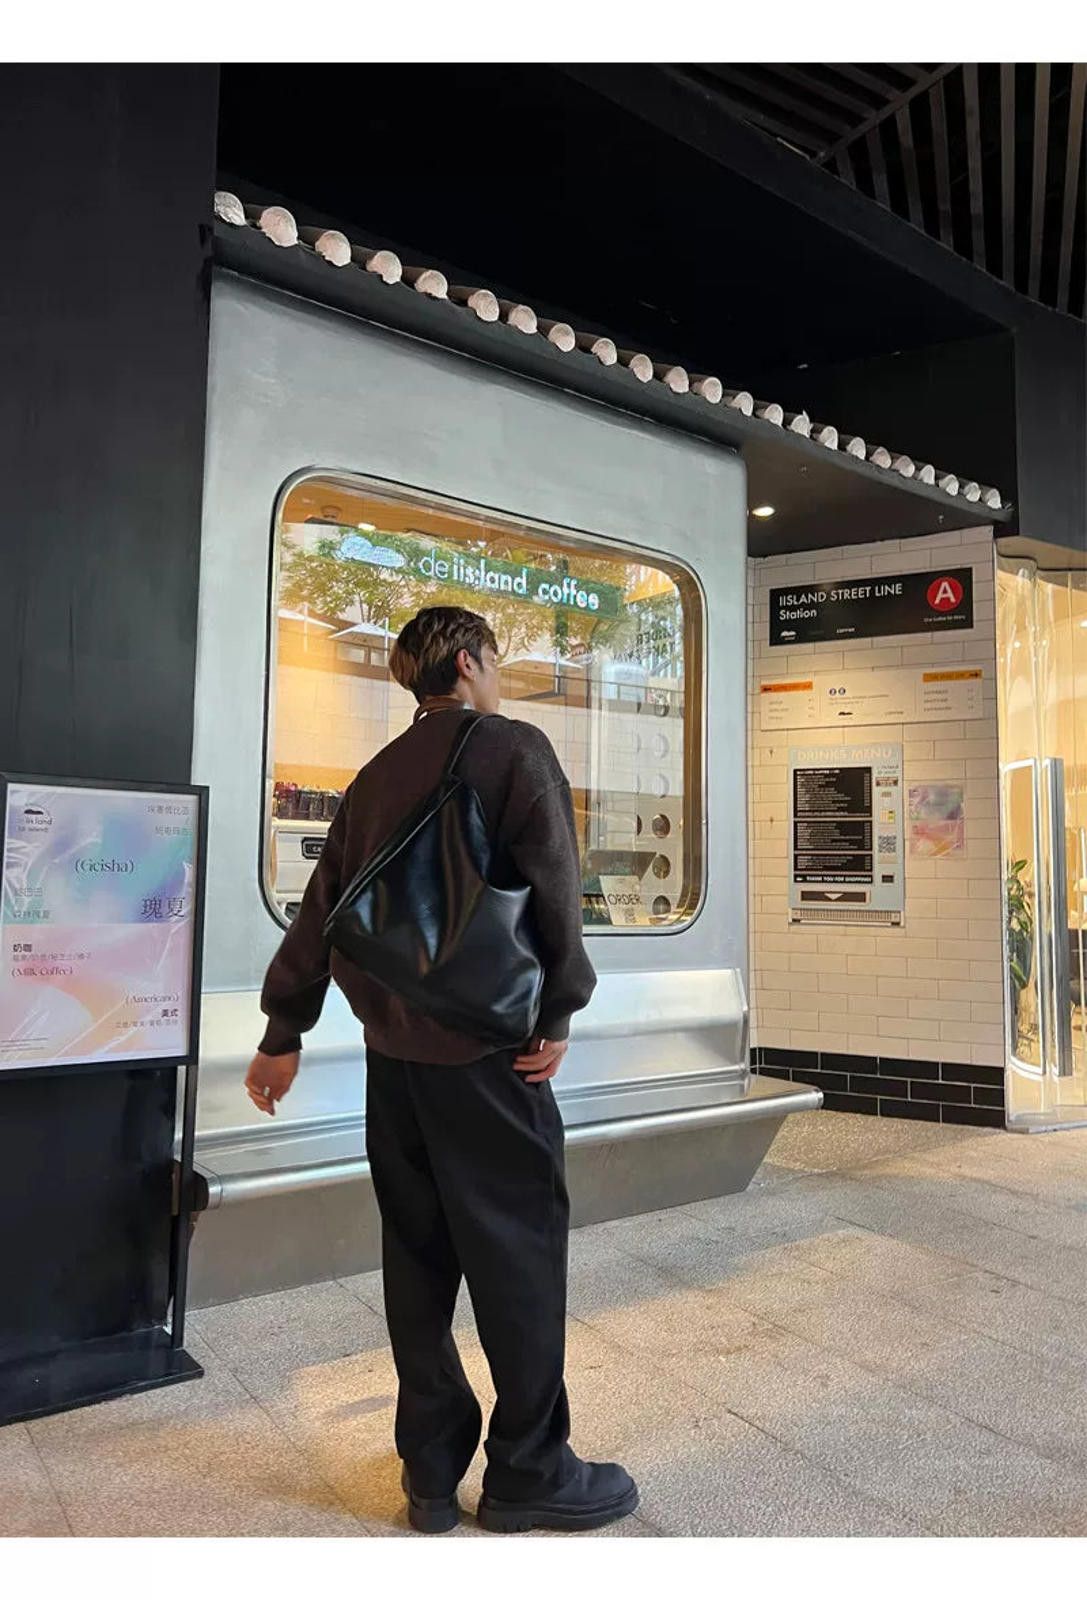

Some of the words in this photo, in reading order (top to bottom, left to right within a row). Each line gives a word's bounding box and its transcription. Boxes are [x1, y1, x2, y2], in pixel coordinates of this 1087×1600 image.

[419, 549, 449, 579] de
[538, 577, 599, 610] coffee
[779, 591, 827, 606] IISLAND
[830, 585, 872, 600] STREET
[875, 583, 902, 597] LINE
[934, 581, 956, 604] A
[779, 608, 817, 621] Station
[798, 750, 847, 761] DRINKS
[851, 747, 892, 759] MENU
[75, 858, 134, 873] (Geisha)
[140, 896, 186, 919] 瑰夏
[608, 893, 640, 905] ORDER
